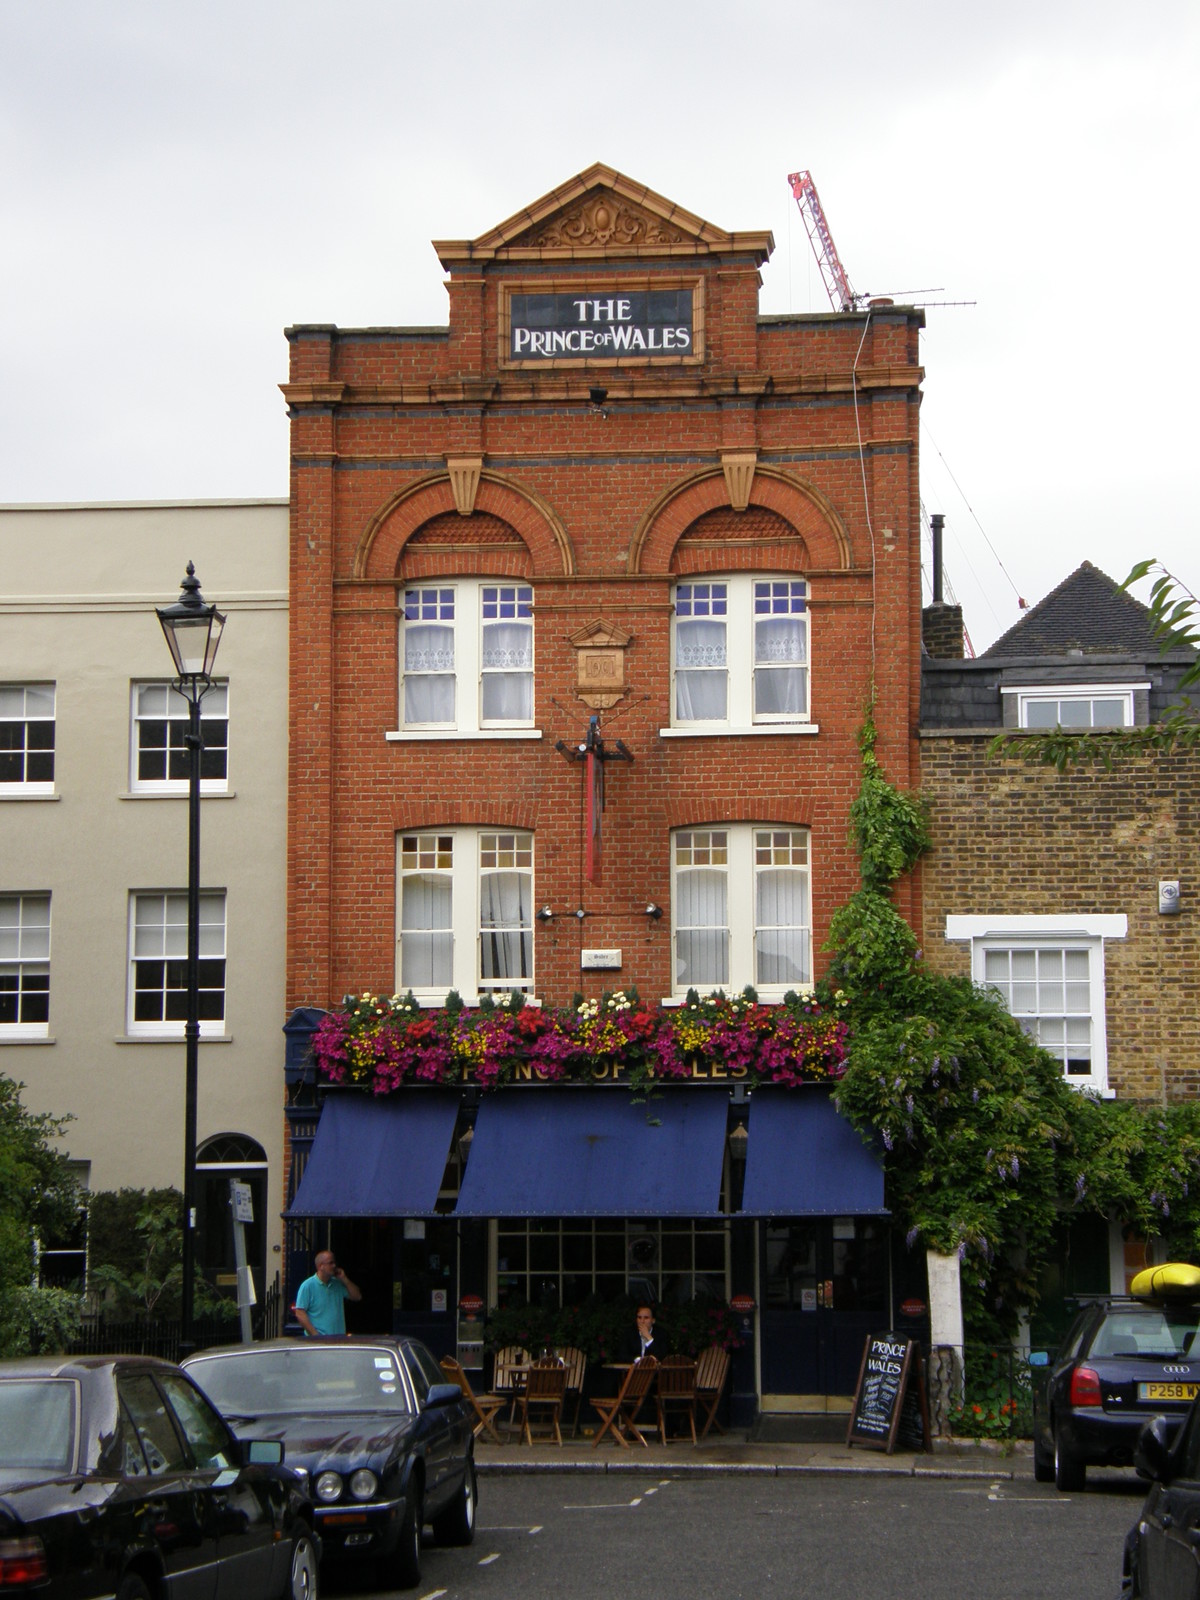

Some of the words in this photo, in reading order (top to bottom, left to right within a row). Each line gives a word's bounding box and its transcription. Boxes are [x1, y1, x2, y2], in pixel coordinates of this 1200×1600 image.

[573, 299, 632, 322] THE
[514, 327, 595, 356] PRINCE
[593, 333, 612, 346] OF
[609, 325, 690, 350] WALES
[872, 1341, 906, 1357] PRINCE
[868, 1359, 902, 1374] WALES
[1149, 1384, 1183, 1398] P258
